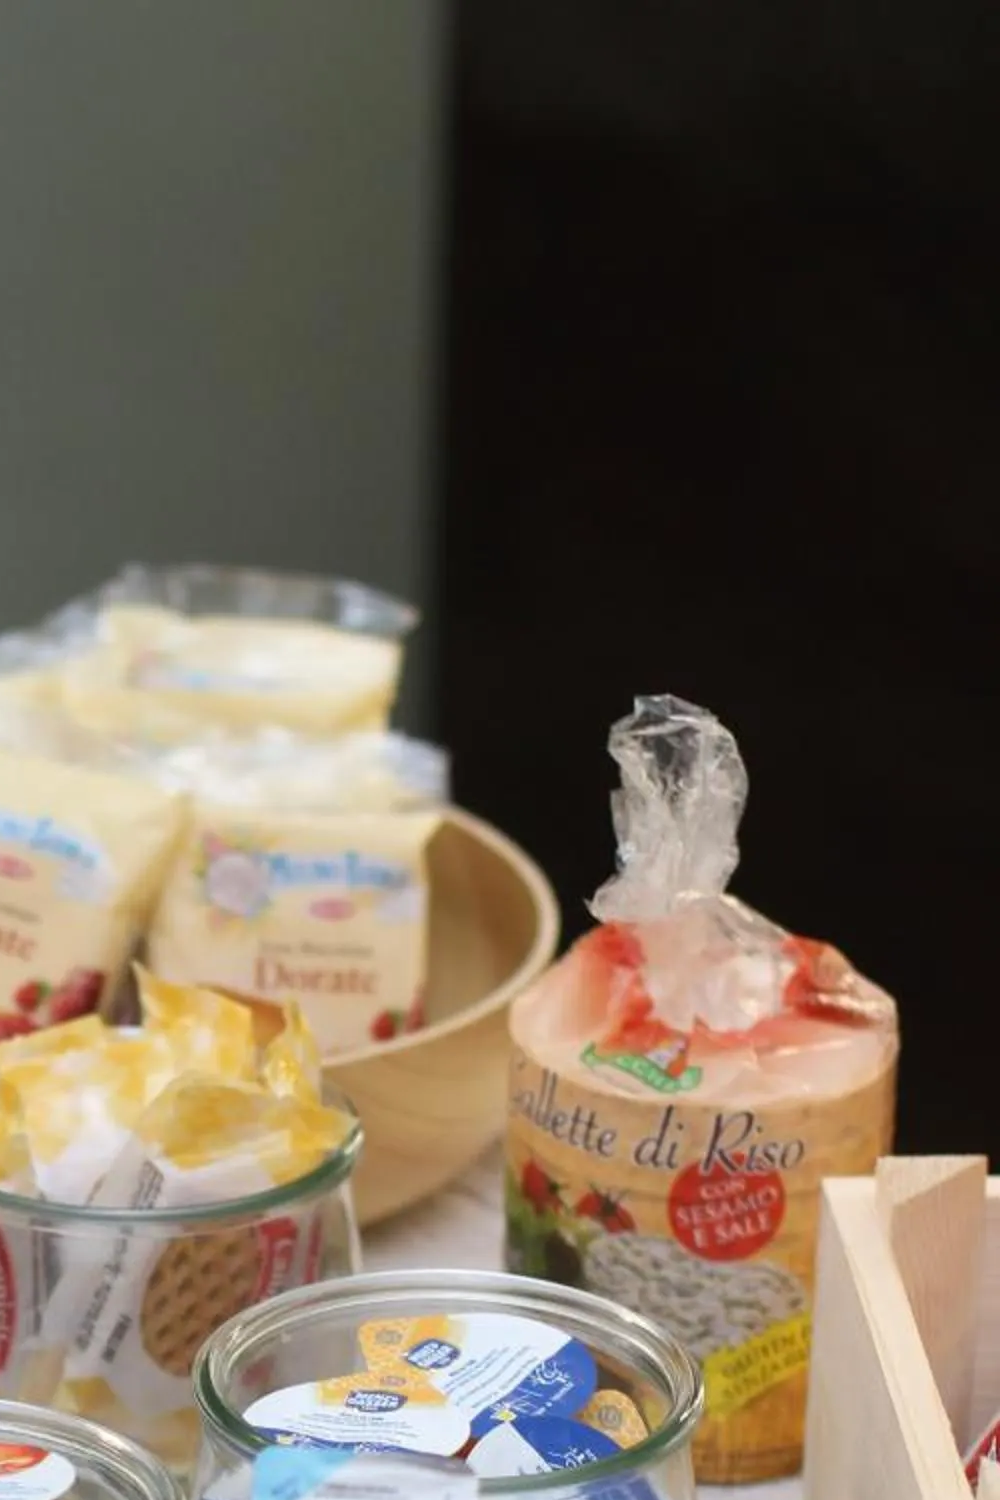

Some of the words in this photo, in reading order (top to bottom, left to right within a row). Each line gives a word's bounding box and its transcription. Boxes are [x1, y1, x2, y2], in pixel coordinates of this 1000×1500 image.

[633, 1104, 687, 1170] di
[703, 1110, 805, 1174] Riso
[676, 1186, 779, 1225] SESAMO
[700, 1178, 746, 1199] CON
[715, 1210, 770, 1245] SALE
